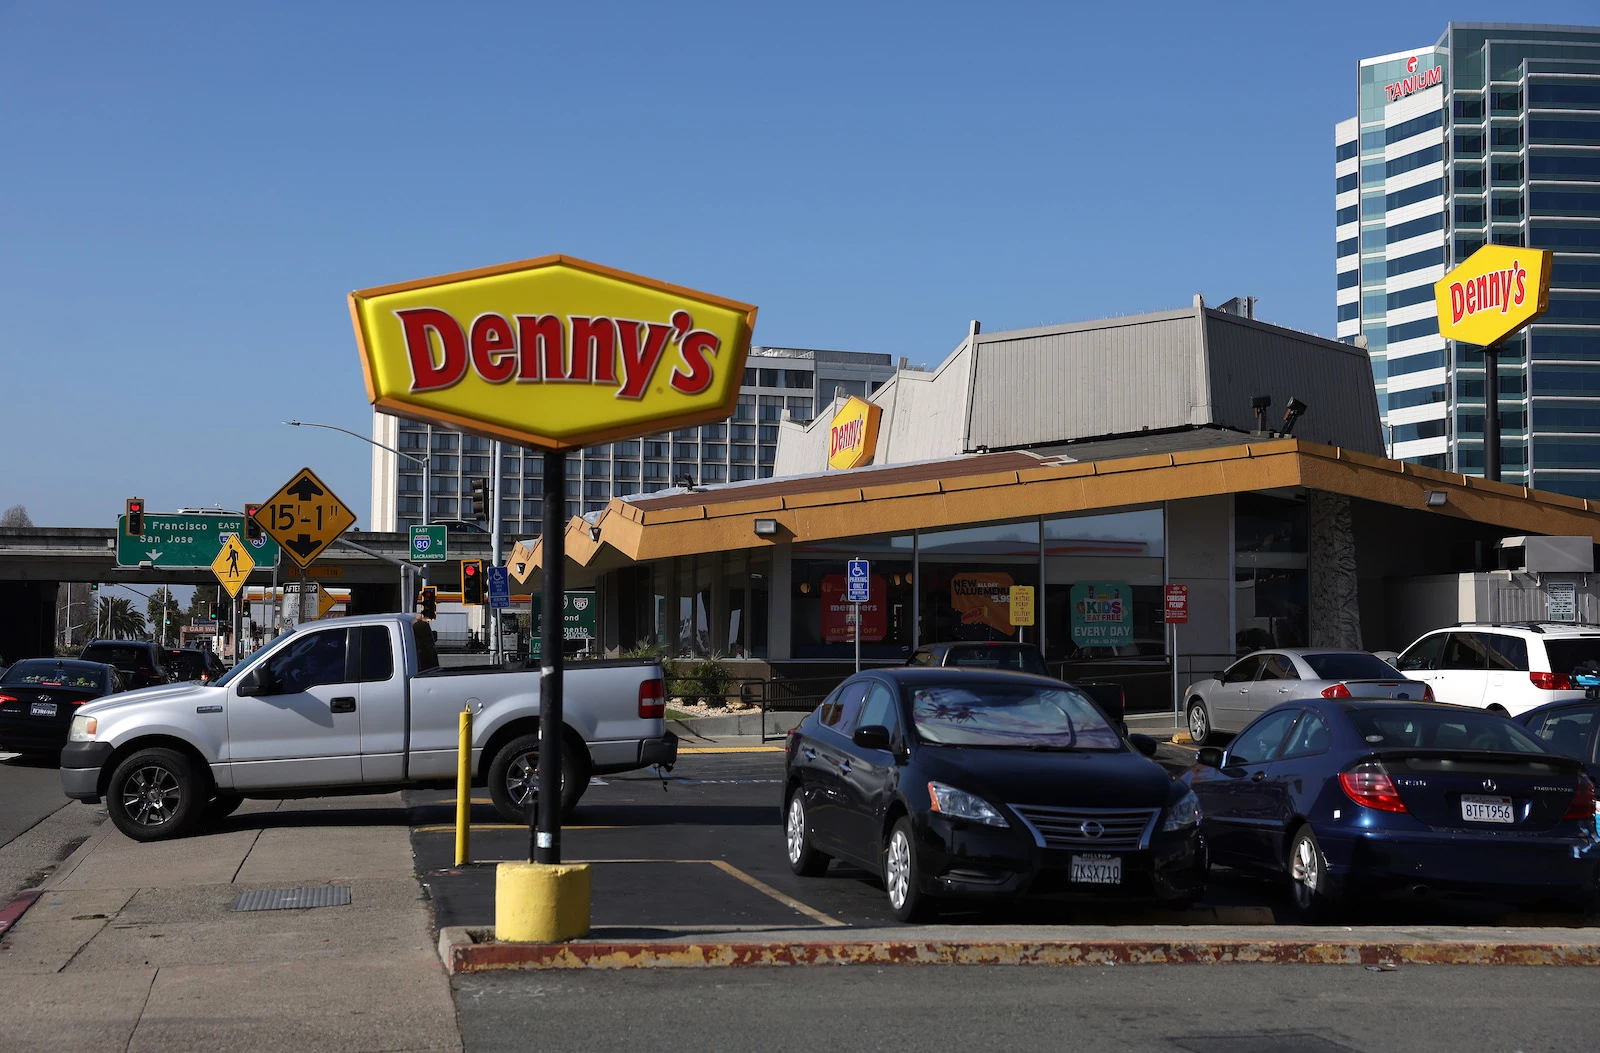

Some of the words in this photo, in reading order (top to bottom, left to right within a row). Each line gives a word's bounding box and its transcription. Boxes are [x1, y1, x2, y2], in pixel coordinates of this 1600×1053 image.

[1385, 65, 1442, 101] TANIUM
[1450, 260, 1527, 325] Denny's
[392, 307, 721, 400] Denny's
[830, 412, 864, 459] Denny's
[152, 521, 208, 531] Francisco
[140, 534, 161, 543] San
[167, 534, 194, 544] Jose
[954, 580, 977, 588] NEW
[954, 587, 983, 596] VALUE
[984, 587, 1010, 595] MENU
[1086, 601, 1121, 614] KIDS
[1075, 627, 1107, 637] EVERY
[1110, 626, 1131, 636] DAY
[1466, 804, 1510, 818] 8TFT956
[1073, 864, 1119, 881] 7KSX710
